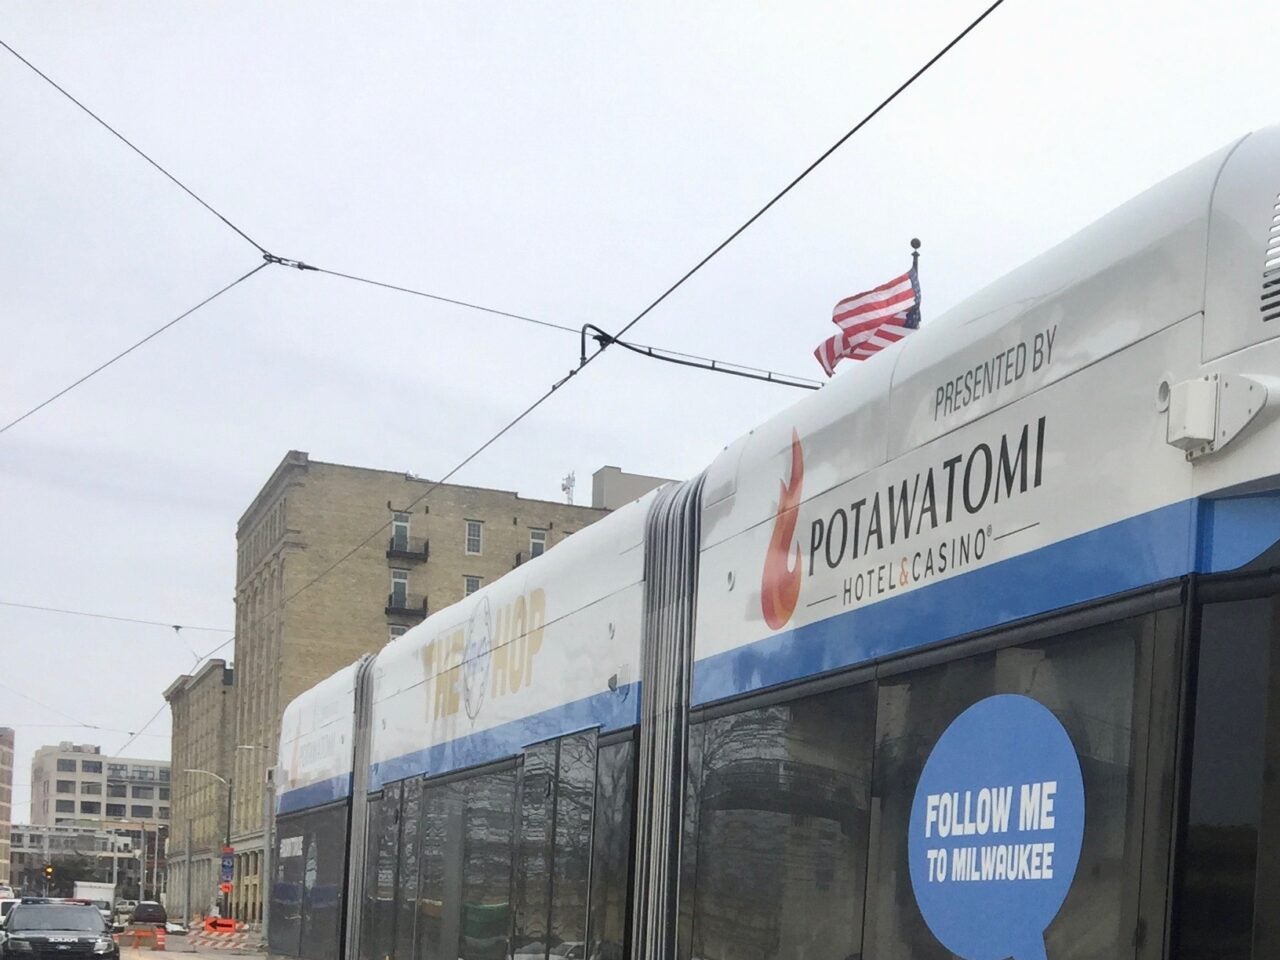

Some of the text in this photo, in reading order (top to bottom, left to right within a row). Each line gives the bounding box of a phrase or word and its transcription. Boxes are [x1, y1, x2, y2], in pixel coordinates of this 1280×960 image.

[934, 325, 1058, 421] PRESENTED BY
[809, 416, 1047, 576] POTAWATOMI
[491, 588, 546, 699] HOP
[925, 781, 1057, 838] FOLLOW ME
[927, 843, 1055, 882] TO MILWAUKEE
